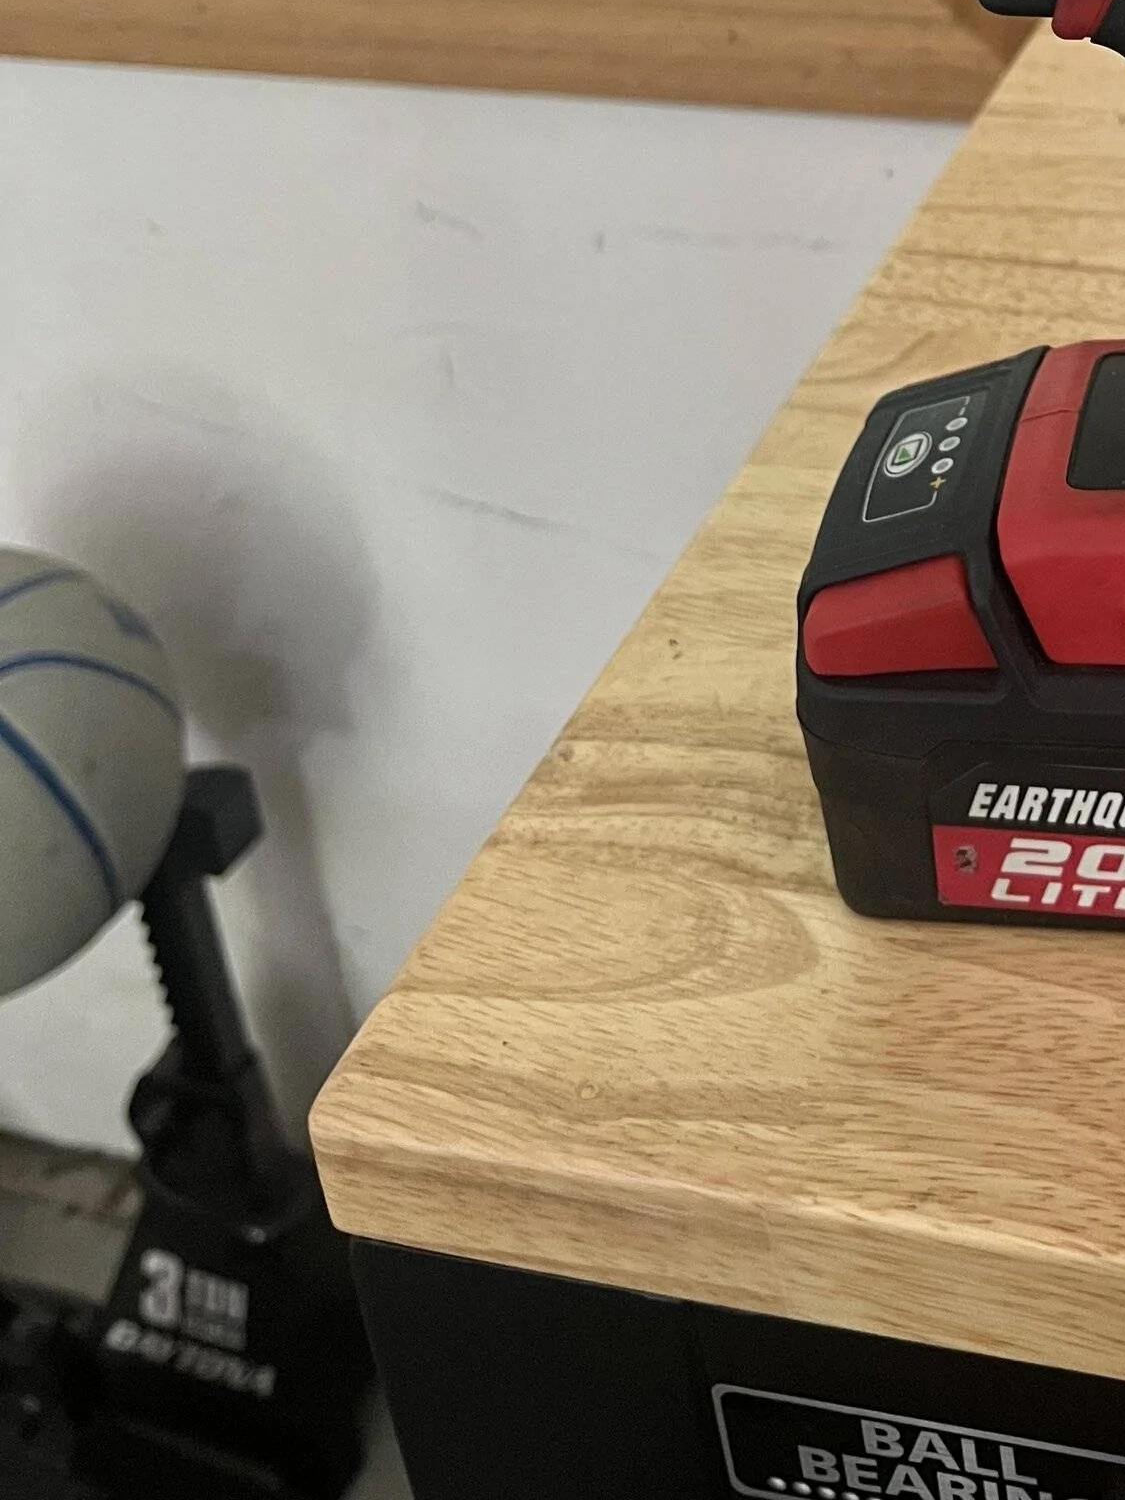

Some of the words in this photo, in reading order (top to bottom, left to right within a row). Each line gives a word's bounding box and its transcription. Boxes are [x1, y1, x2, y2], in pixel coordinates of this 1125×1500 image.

[138, 1247, 183, 1328] 3
[797, 1445, 1088, 1500] BEARI
[860, 1419, 1038, 1485] BALL
